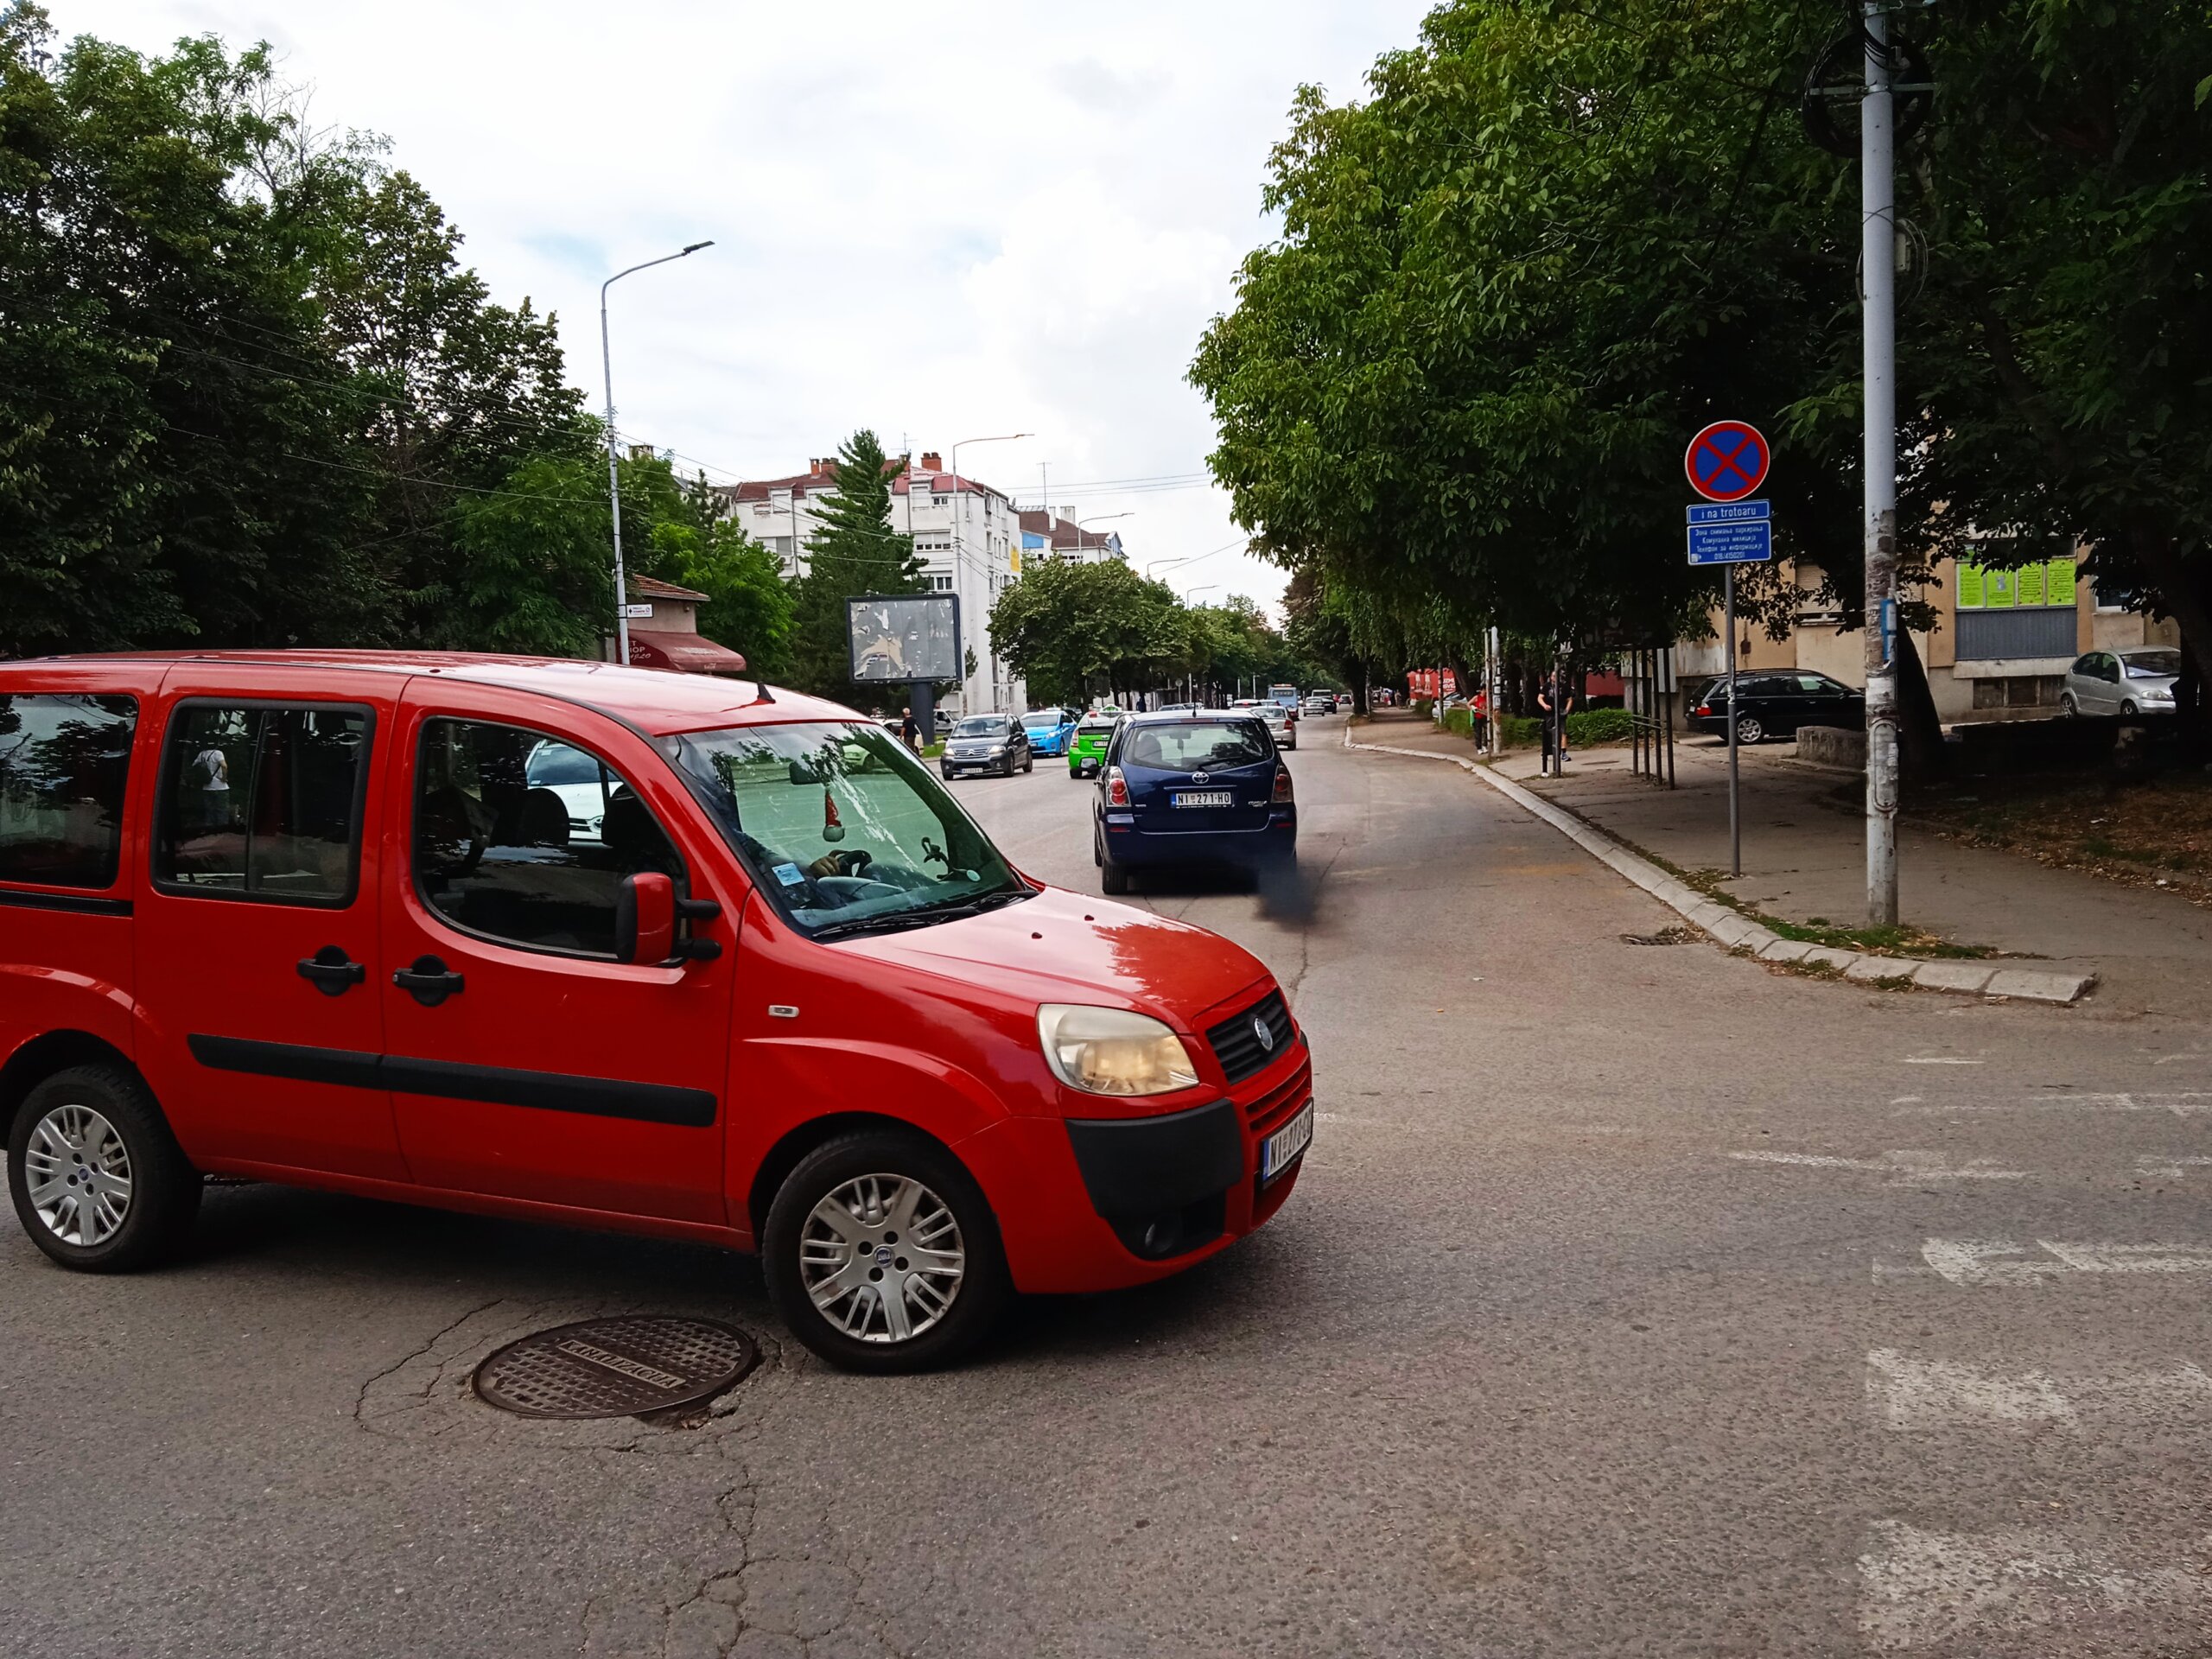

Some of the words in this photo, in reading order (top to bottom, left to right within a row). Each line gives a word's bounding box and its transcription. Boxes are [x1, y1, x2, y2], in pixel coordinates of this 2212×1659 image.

[1701, 509, 1705, 519] i
[1720, 506, 1757, 518] trotoaru
[1178, 794, 1188, 804] NI
[1270, 1135, 1282, 1172] NI
[564, 1341, 678, 1388] KANALIZACIJA
